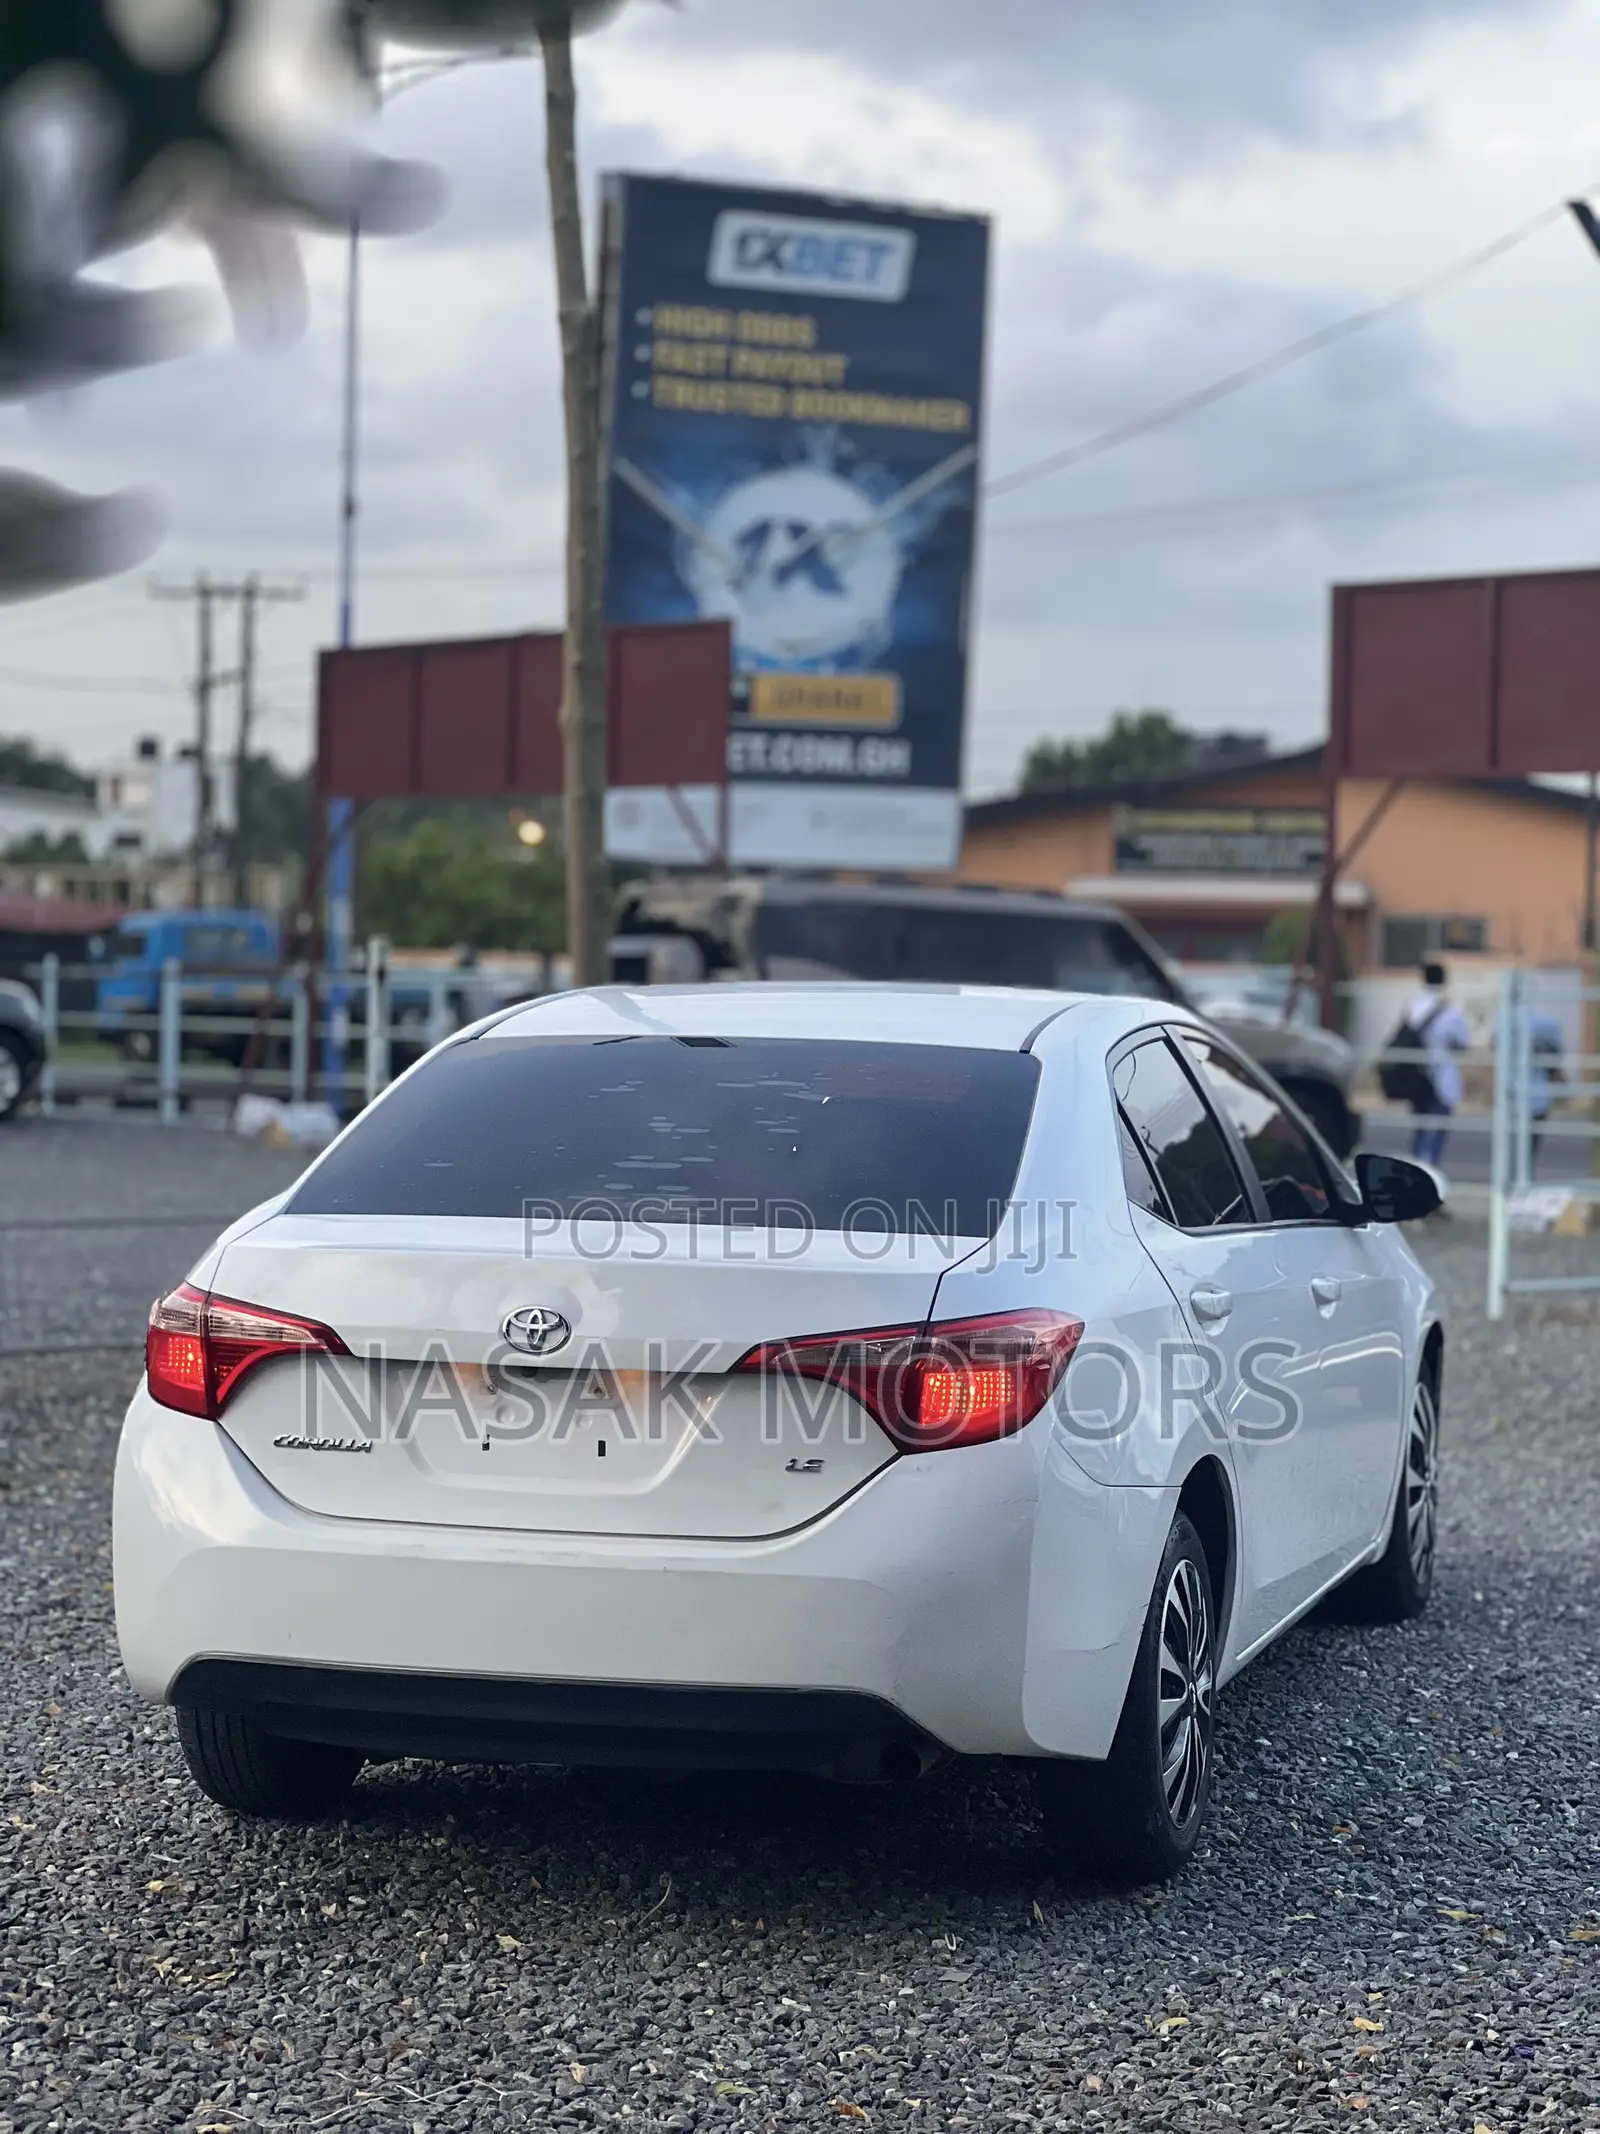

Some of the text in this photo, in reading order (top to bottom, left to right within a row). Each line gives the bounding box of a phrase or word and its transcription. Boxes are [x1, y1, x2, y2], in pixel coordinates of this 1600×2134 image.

[732, 226, 894, 282] 1XBET
[653, 303, 732, 340] HIGH
[653, 340, 847, 384] FAST PAYOUT
[654, 376, 971, 431] TRUSTED BOOKMAKER
[273, 1434, 373, 1454] COROLLA
[785, 1457, 825, 1475] LE
